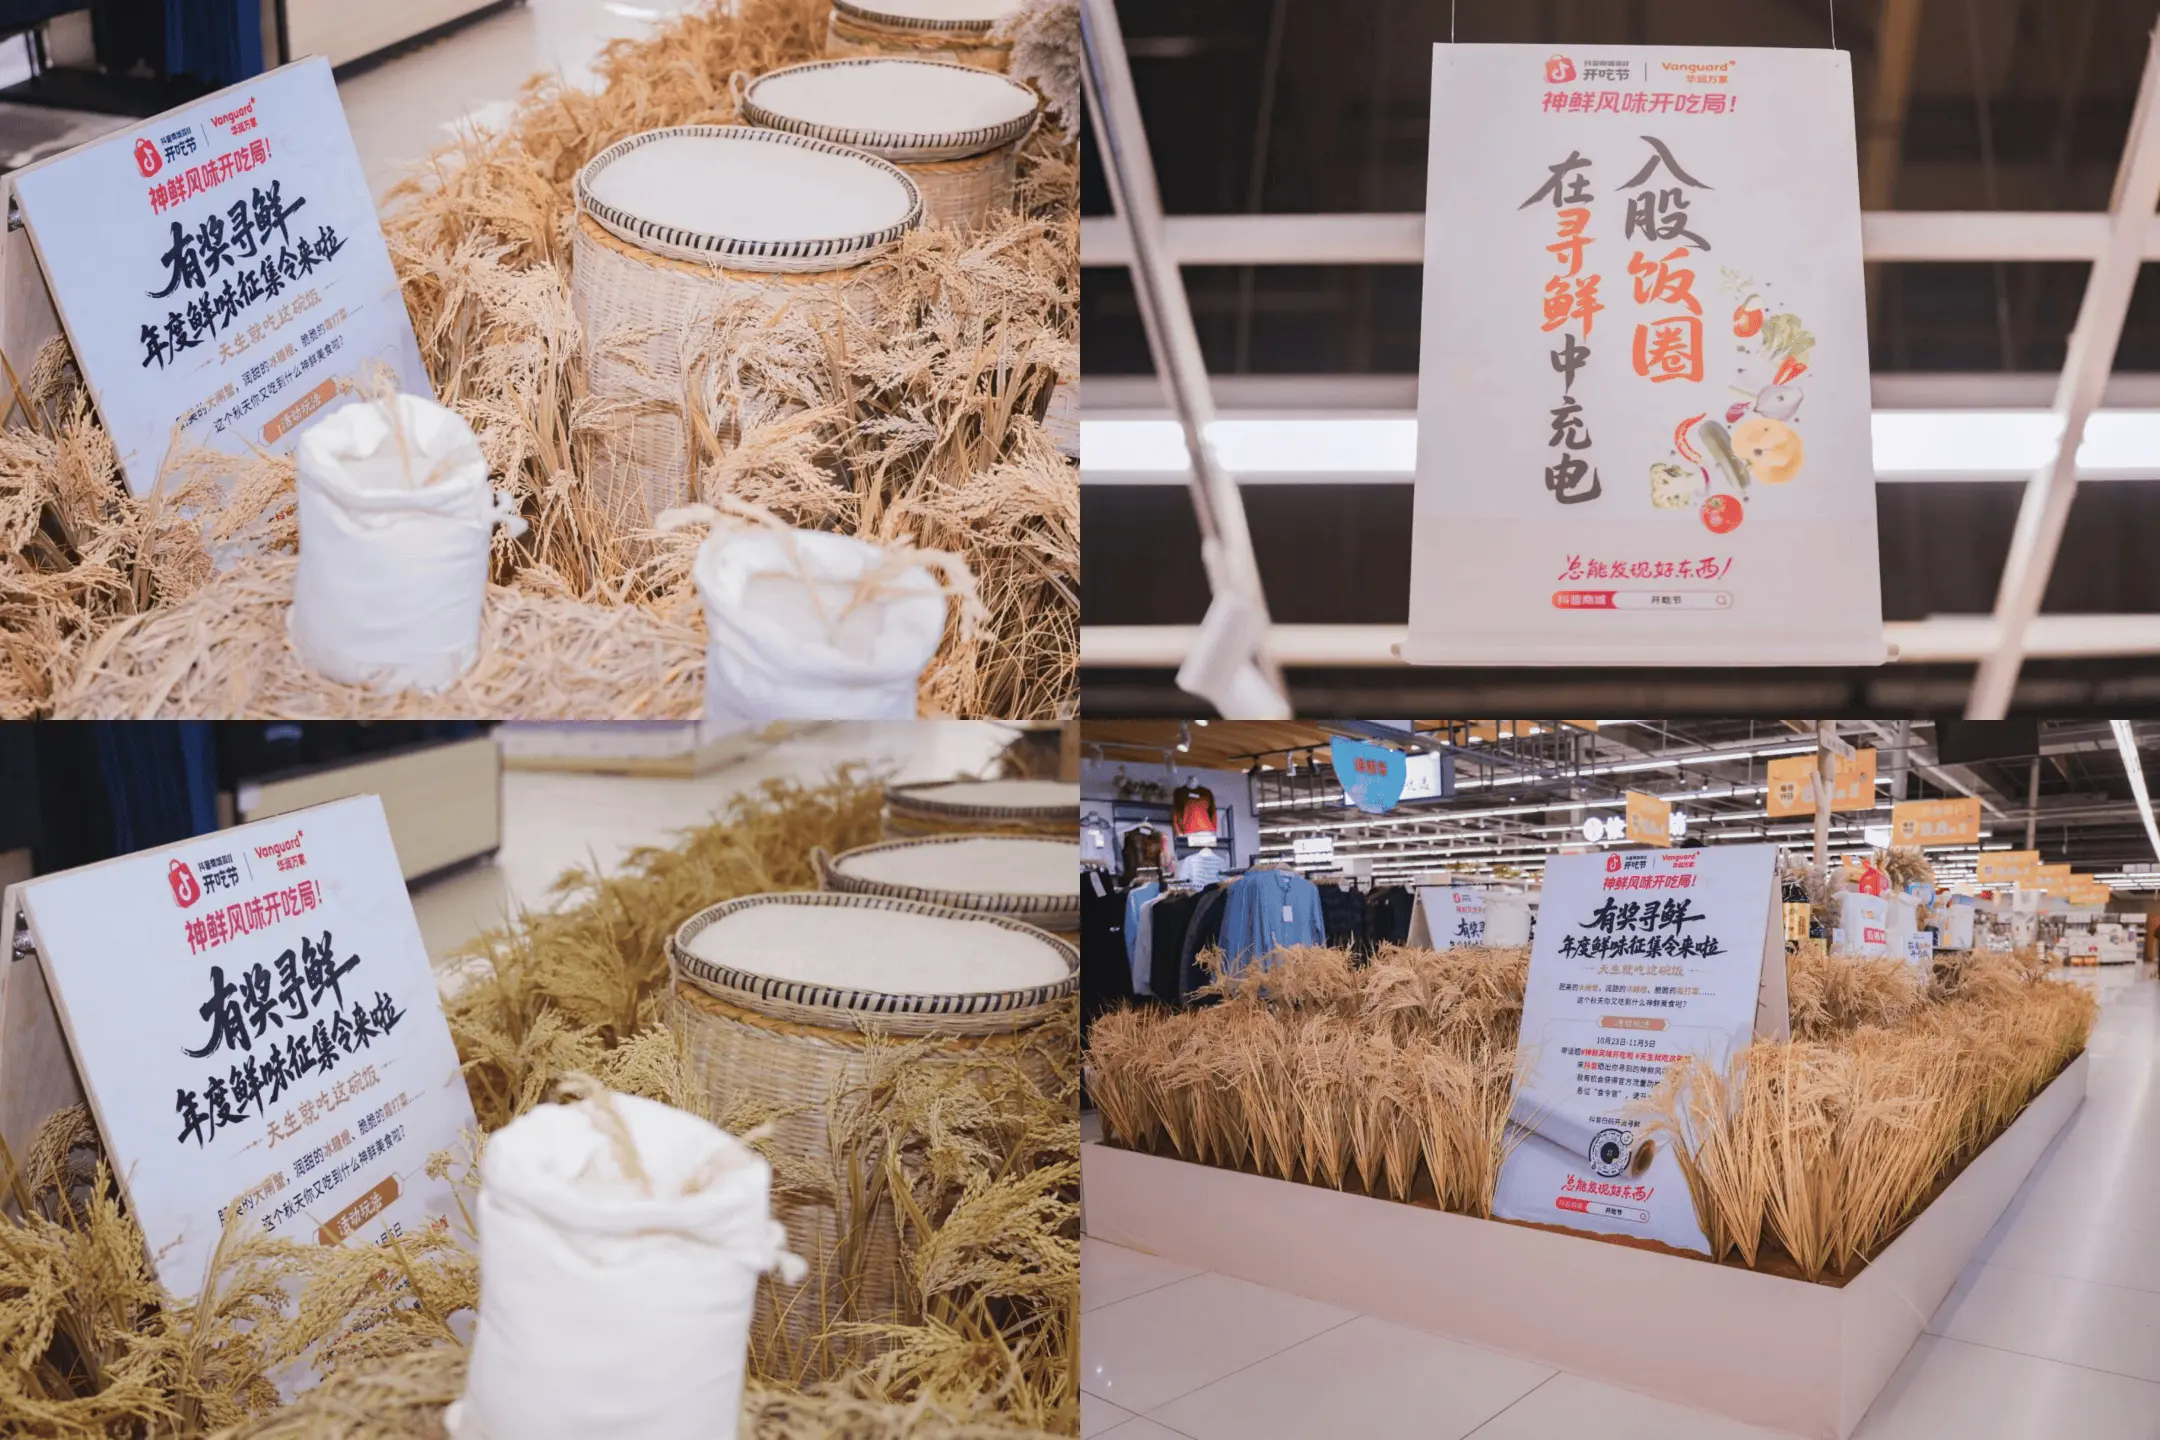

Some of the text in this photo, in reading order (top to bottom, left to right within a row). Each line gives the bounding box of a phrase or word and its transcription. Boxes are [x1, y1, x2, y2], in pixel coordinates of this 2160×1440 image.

[1582, 68, 1630, 81] 开吃节
[1661, 61, 1728, 74] Vanguard
[1686, 74, 1728, 84] 华润万家
[211, 102, 253, 128] Vanguard
[1542, 91, 1737, 114] 神鲜风味开吃局！
[231, 116, 258, 136] 华润万家
[164, 137, 197, 163] 开吃节
[148, 137, 272, 215] 神鲜风味开吃局！
[145, 180, 306, 299] 有奖寻鲜
[1616, 135, 1716, 383] 入股饭圈
[139, 225, 348, 371] 年度鲜味征集令来啦
[219, 288, 322, 365] 天生就吃这碗饭
[1517, 150, 1604, 505] 在寻鲜中充电
[1558, 554, 1733, 580] 总能发现好东西！
[254, 835, 301, 858] Vanguard
[1662, 853, 1696, 862] Vanguard
[276, 853, 307, 872] 华润万家
[1624, 860, 1647, 869] 开吃节
[202, 866, 239, 894] 开吃节
[1603, 874, 1697, 890] 神鲜风味开吃局！
[185, 879, 323, 955] 神鲜风味开吃局！
[1578, 897, 1706, 936] 有奖寻鲜
[1558, 935, 1728, 960] 年度鲜味征集令来啦
[1597, 965, 1684, 977] 天生就吃这碗饭
[180, 930, 361, 1059] 有奖寻鲜
[175, 991, 407, 1150] 年度鲜味征集令来啦
[266, 1064, 381, 1149] 天生就吃这碗饭
[261, 1124, 406, 1233] 这个秋天你又吃到什么神鲜美食啦？
[1561, 1174, 1654, 1202] 总能发现好东西！
[338, 1192, 383, 1236] 活动玩法
